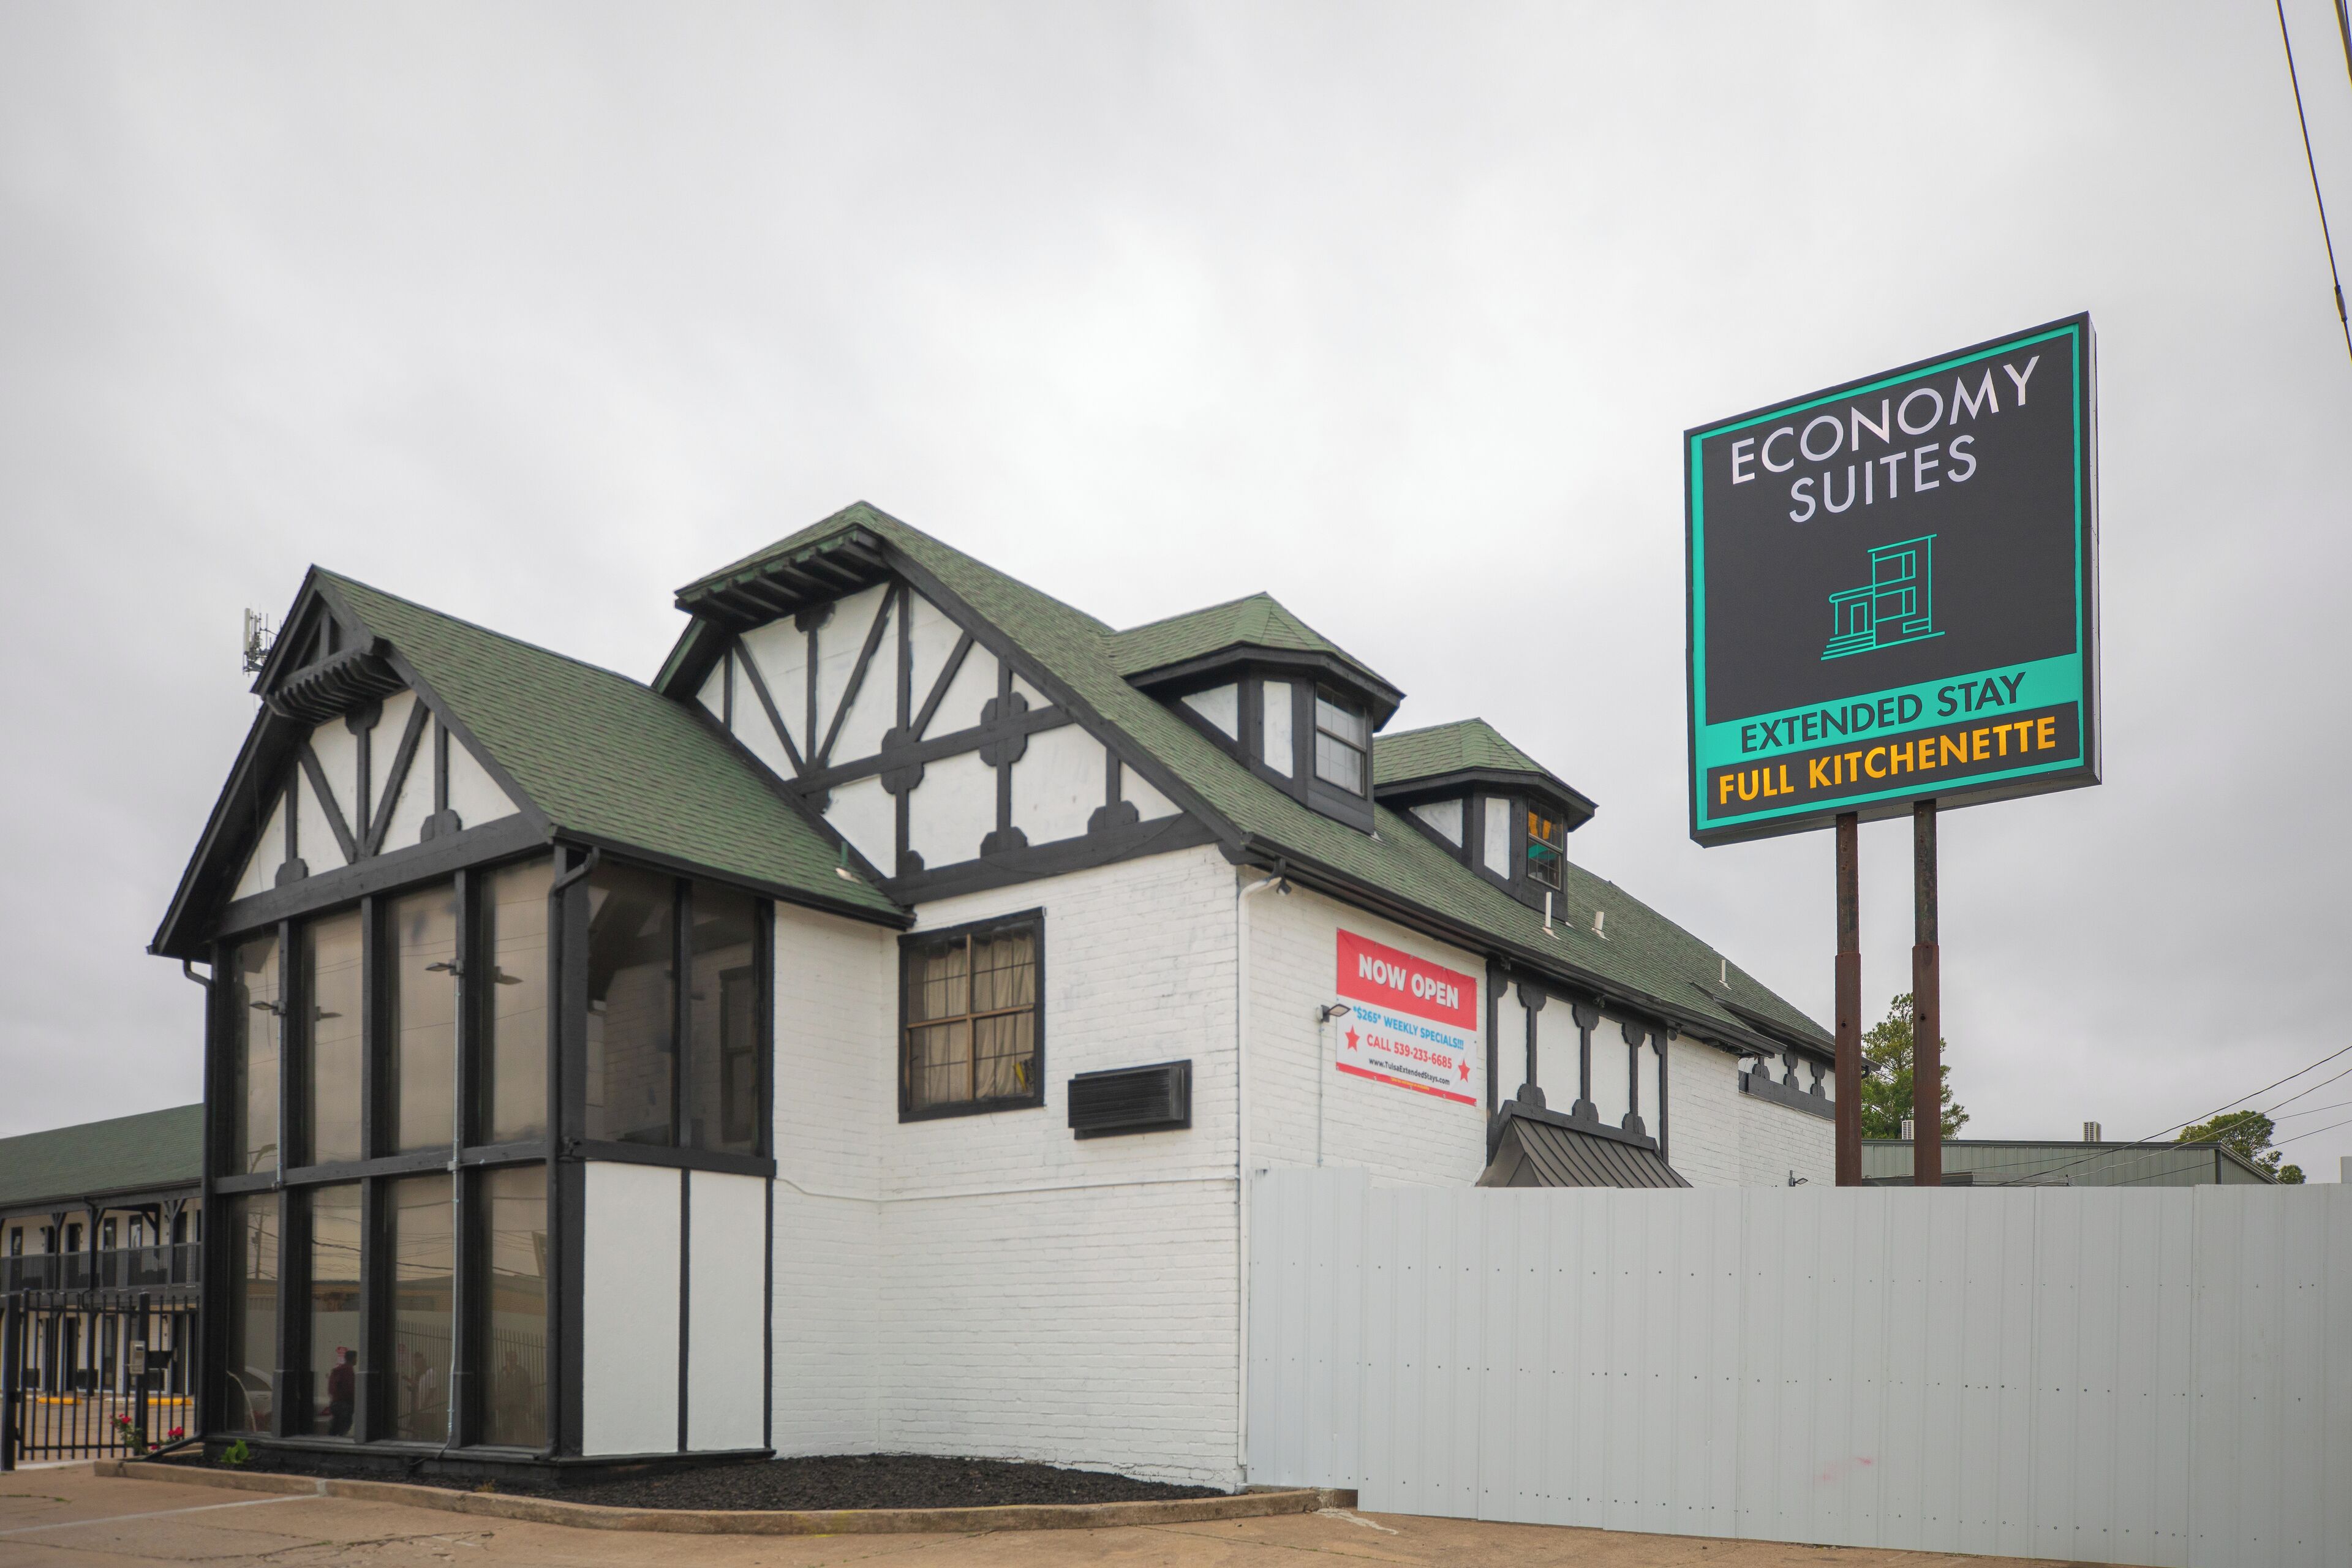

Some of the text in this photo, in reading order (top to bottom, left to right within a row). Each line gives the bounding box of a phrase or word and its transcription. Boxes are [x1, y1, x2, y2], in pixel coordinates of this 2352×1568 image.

[1732, 355, 2040, 485] ECONOMY
[1789, 435, 1977, 523] SUITES
[1741, 671, 2027, 754] EXTENDED STAY
[1719, 716, 2057, 805] FULL KITCHENETTE
[1359, 953, 1459, 1010] NOW OPEN
[1366, 1033, 1453, 1069] CALL 539-233-6685
[1384, 1016, 1419, 1036] WEEKLY
[1420, 1027, 1464, 1050] SPECIALS!!!
[1369, 1058, 1450, 1085] www.TulsaExtendedStays.com
